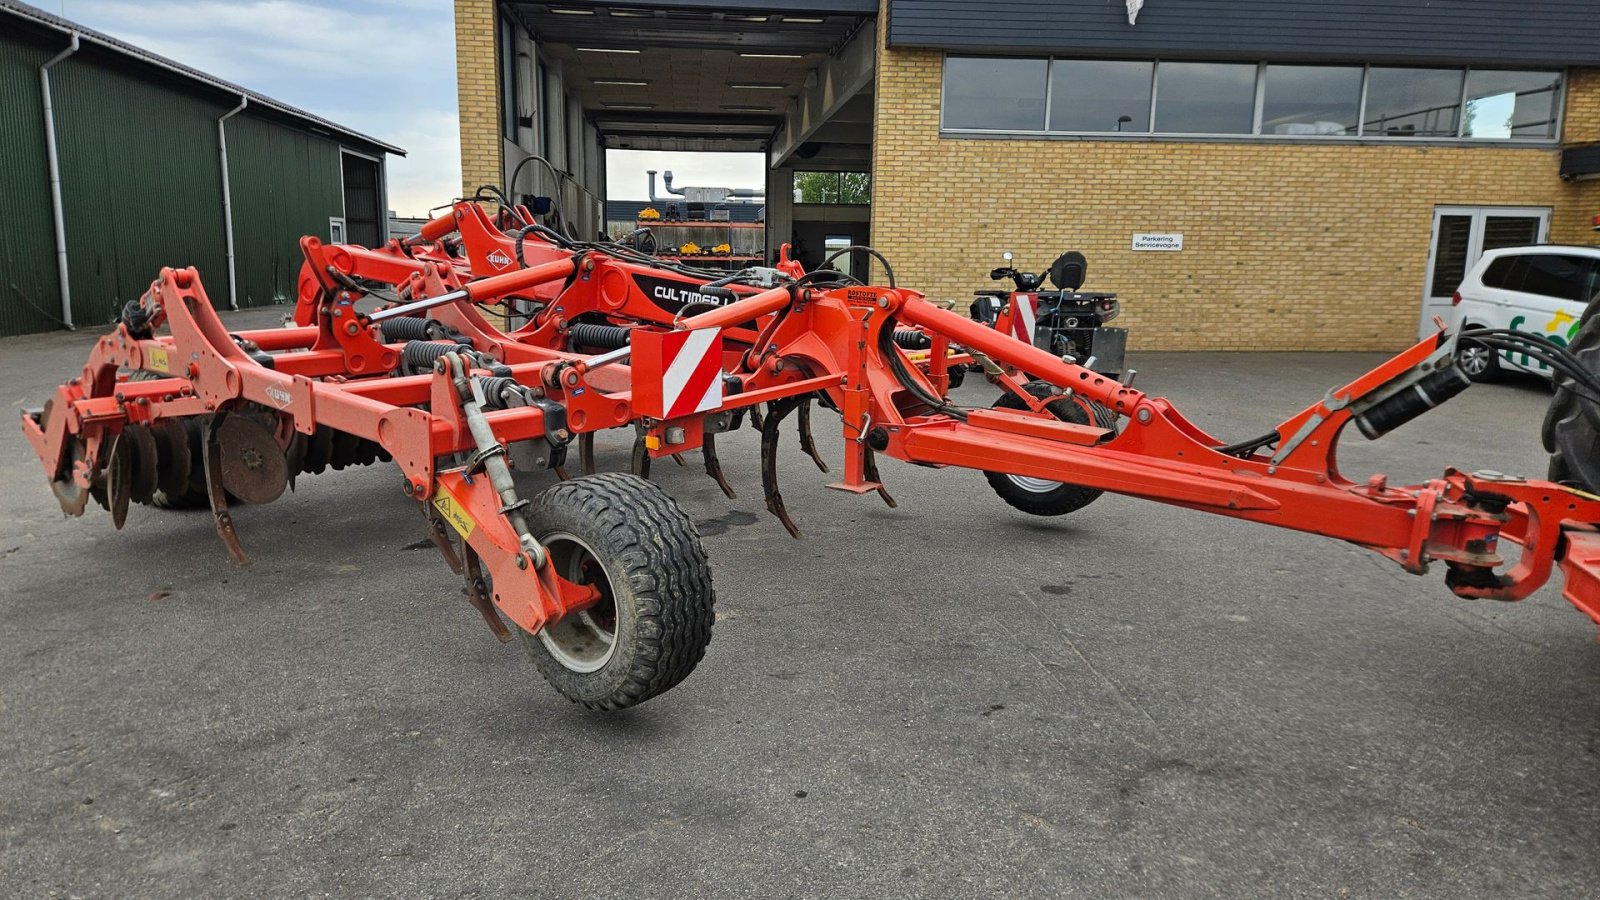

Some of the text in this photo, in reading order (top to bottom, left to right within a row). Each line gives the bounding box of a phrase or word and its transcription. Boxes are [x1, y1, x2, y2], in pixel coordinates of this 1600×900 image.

[489, 255, 509, 265] KUHN
[654, 286, 720, 305] CULTIMER
[268, 387, 291, 403] KUHN
